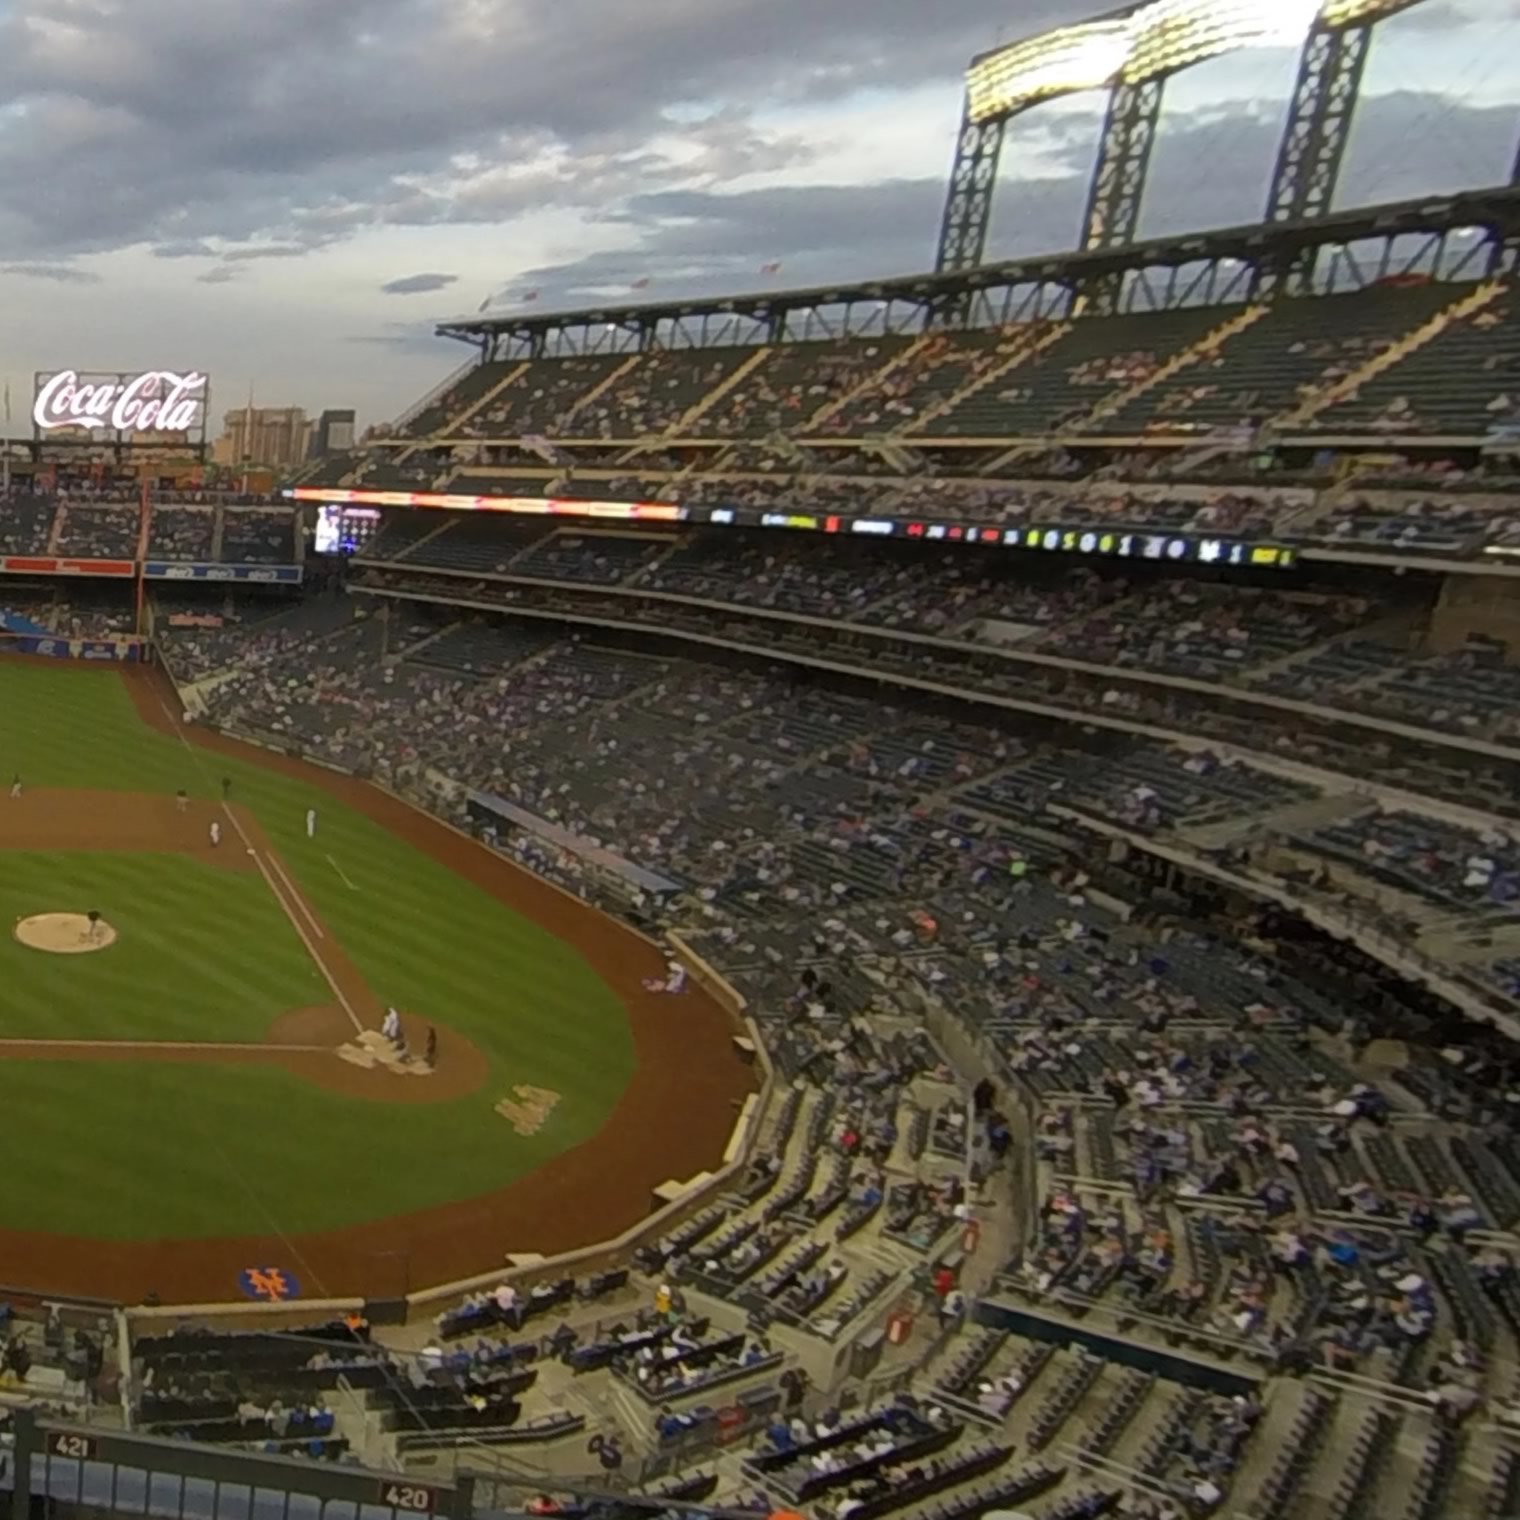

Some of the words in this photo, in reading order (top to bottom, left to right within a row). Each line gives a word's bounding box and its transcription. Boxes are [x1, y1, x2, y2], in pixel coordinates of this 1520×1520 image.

[33, 370, 206, 431] Coca-Cola
[55, 1433, 89, 1457] 421
[385, 1487, 429, 1510] 420
